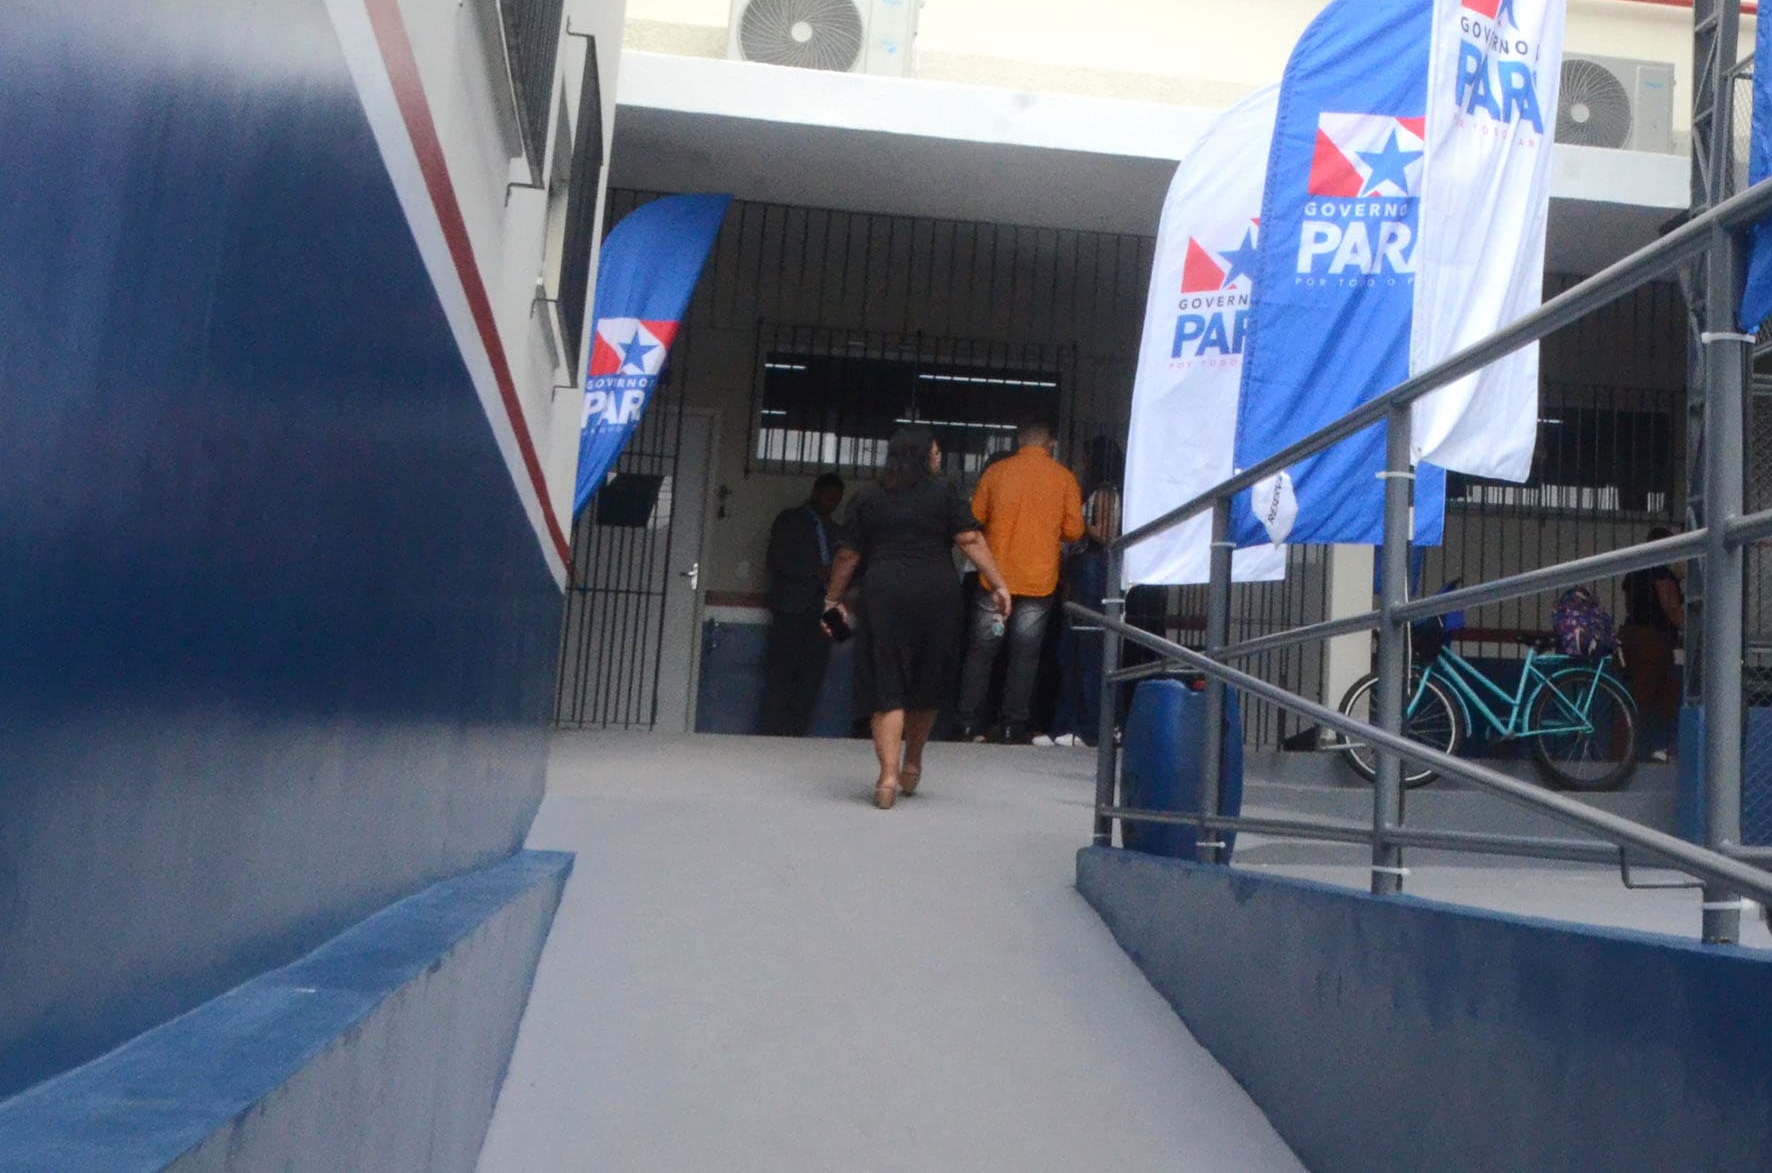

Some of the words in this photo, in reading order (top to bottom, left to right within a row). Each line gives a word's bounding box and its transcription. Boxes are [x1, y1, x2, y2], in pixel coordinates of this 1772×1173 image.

[1461, 16, 1528, 55] GOVRNO
[1304, 202, 1408, 217] GOVERNO
[1297, 221, 1416, 274] PAR
[1179, 294, 1248, 310] GOVERN
[586, 378, 648, 390] GOVRNO
[581, 390, 646, 428] PAR
